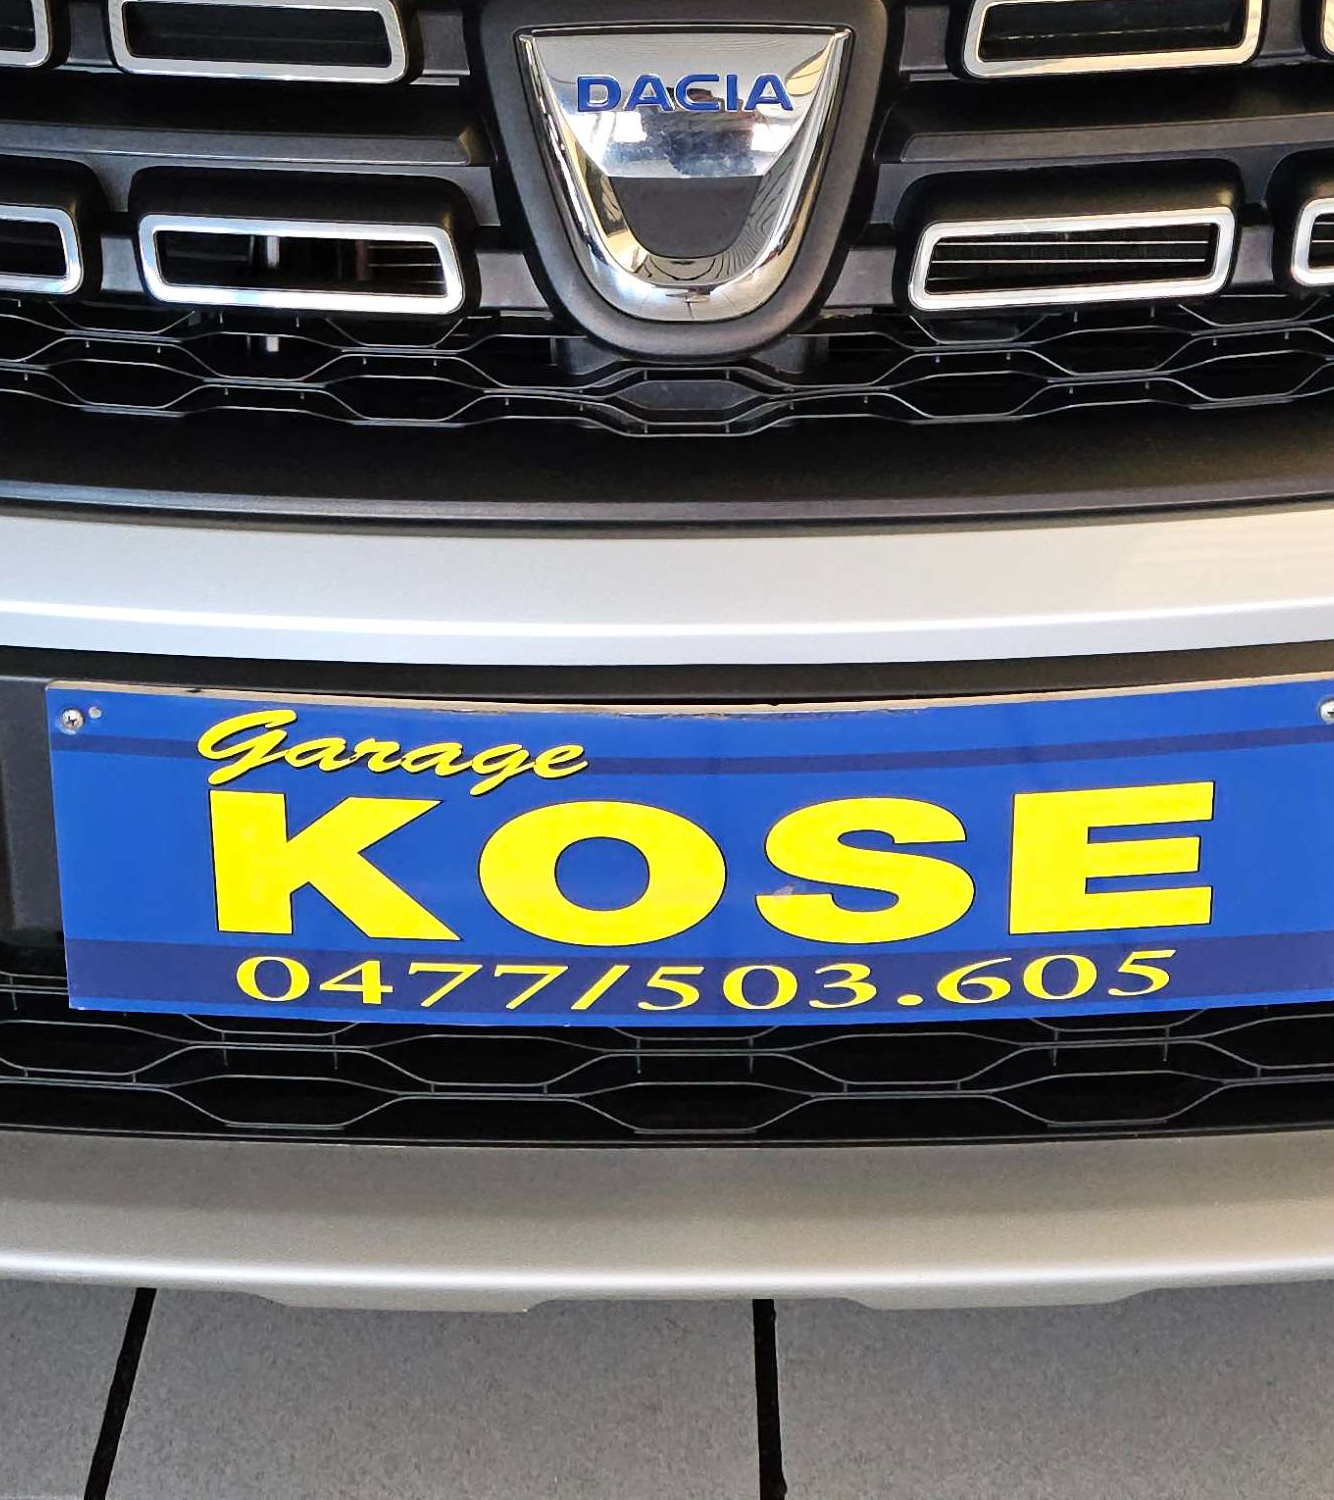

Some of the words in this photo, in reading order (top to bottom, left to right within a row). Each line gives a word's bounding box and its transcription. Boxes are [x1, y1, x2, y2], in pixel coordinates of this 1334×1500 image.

[576, 73, 794, 113] DACIA
[196, 707, 590, 798] Garage
[208, 781, 1215, 947] KOSE
[234, 949, 1175, 1011] 0477/503.605
